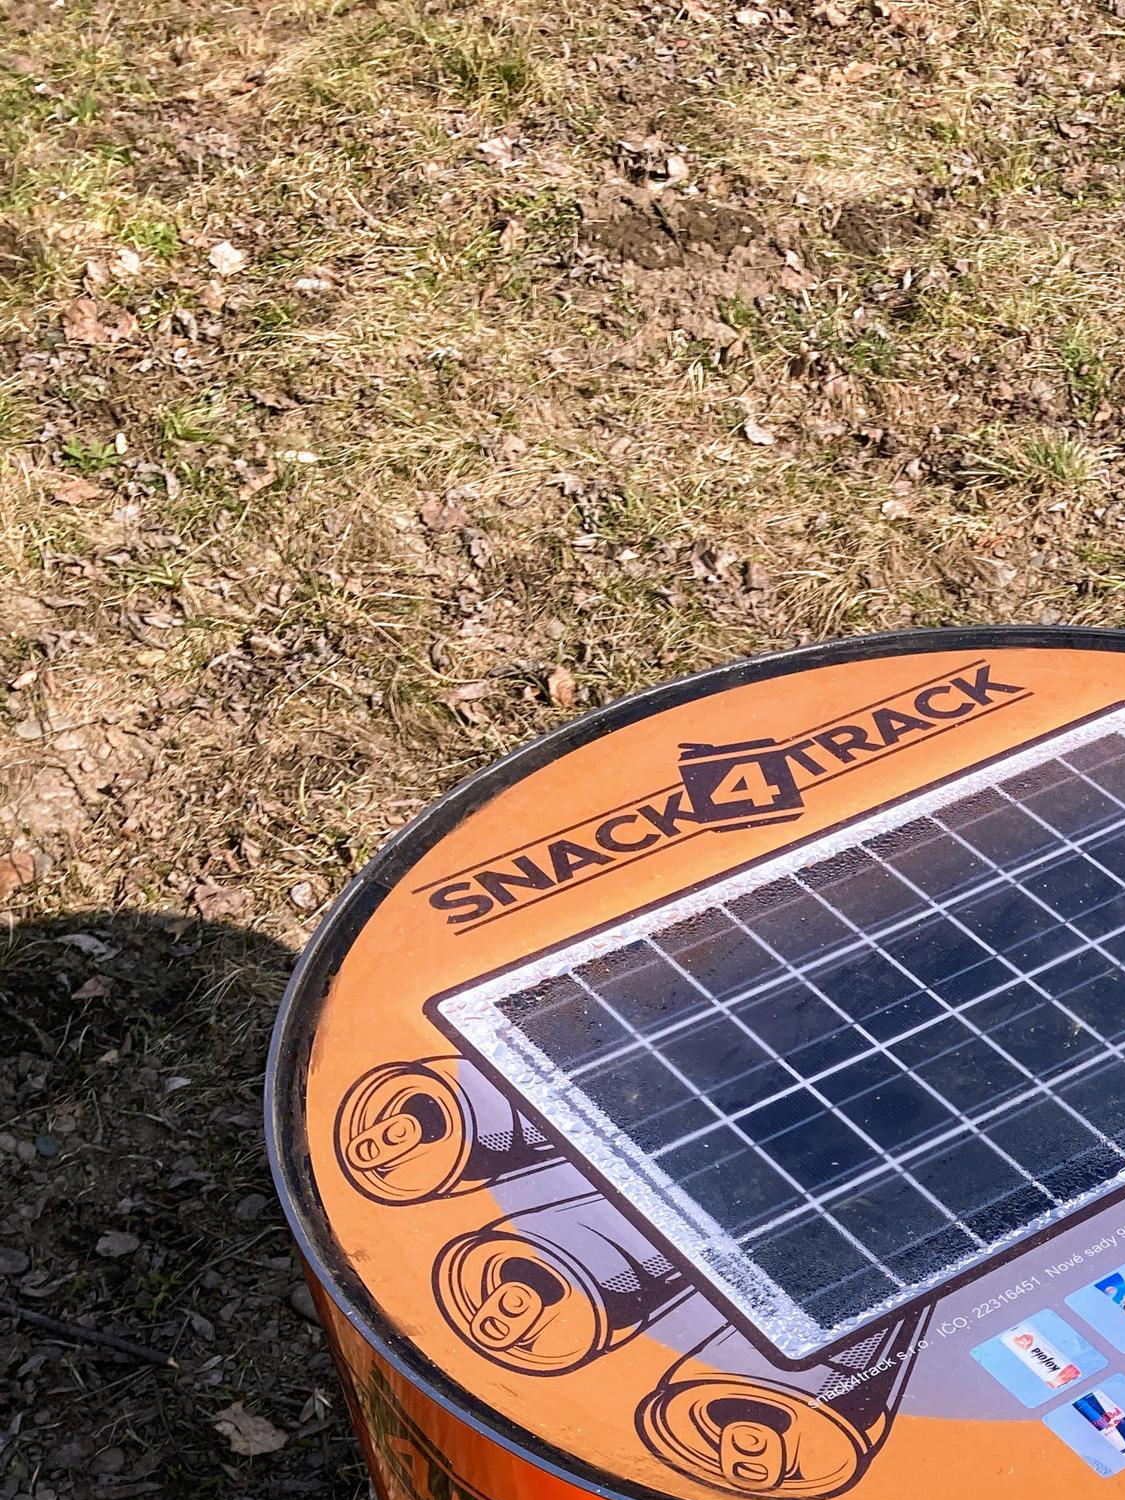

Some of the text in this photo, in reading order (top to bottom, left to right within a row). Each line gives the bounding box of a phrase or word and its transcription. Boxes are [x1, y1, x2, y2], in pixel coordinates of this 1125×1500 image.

[808, 1357, 897, 1409] snack4track
[896, 1339, 934, 1362] s.r.o.
[936, 1315, 974, 1338] IČO:
[972, 1276, 1041, 1319] 22316451
[1045, 1253, 1083, 1278] Nové
[1084, 1234, 1118, 1257] sady
